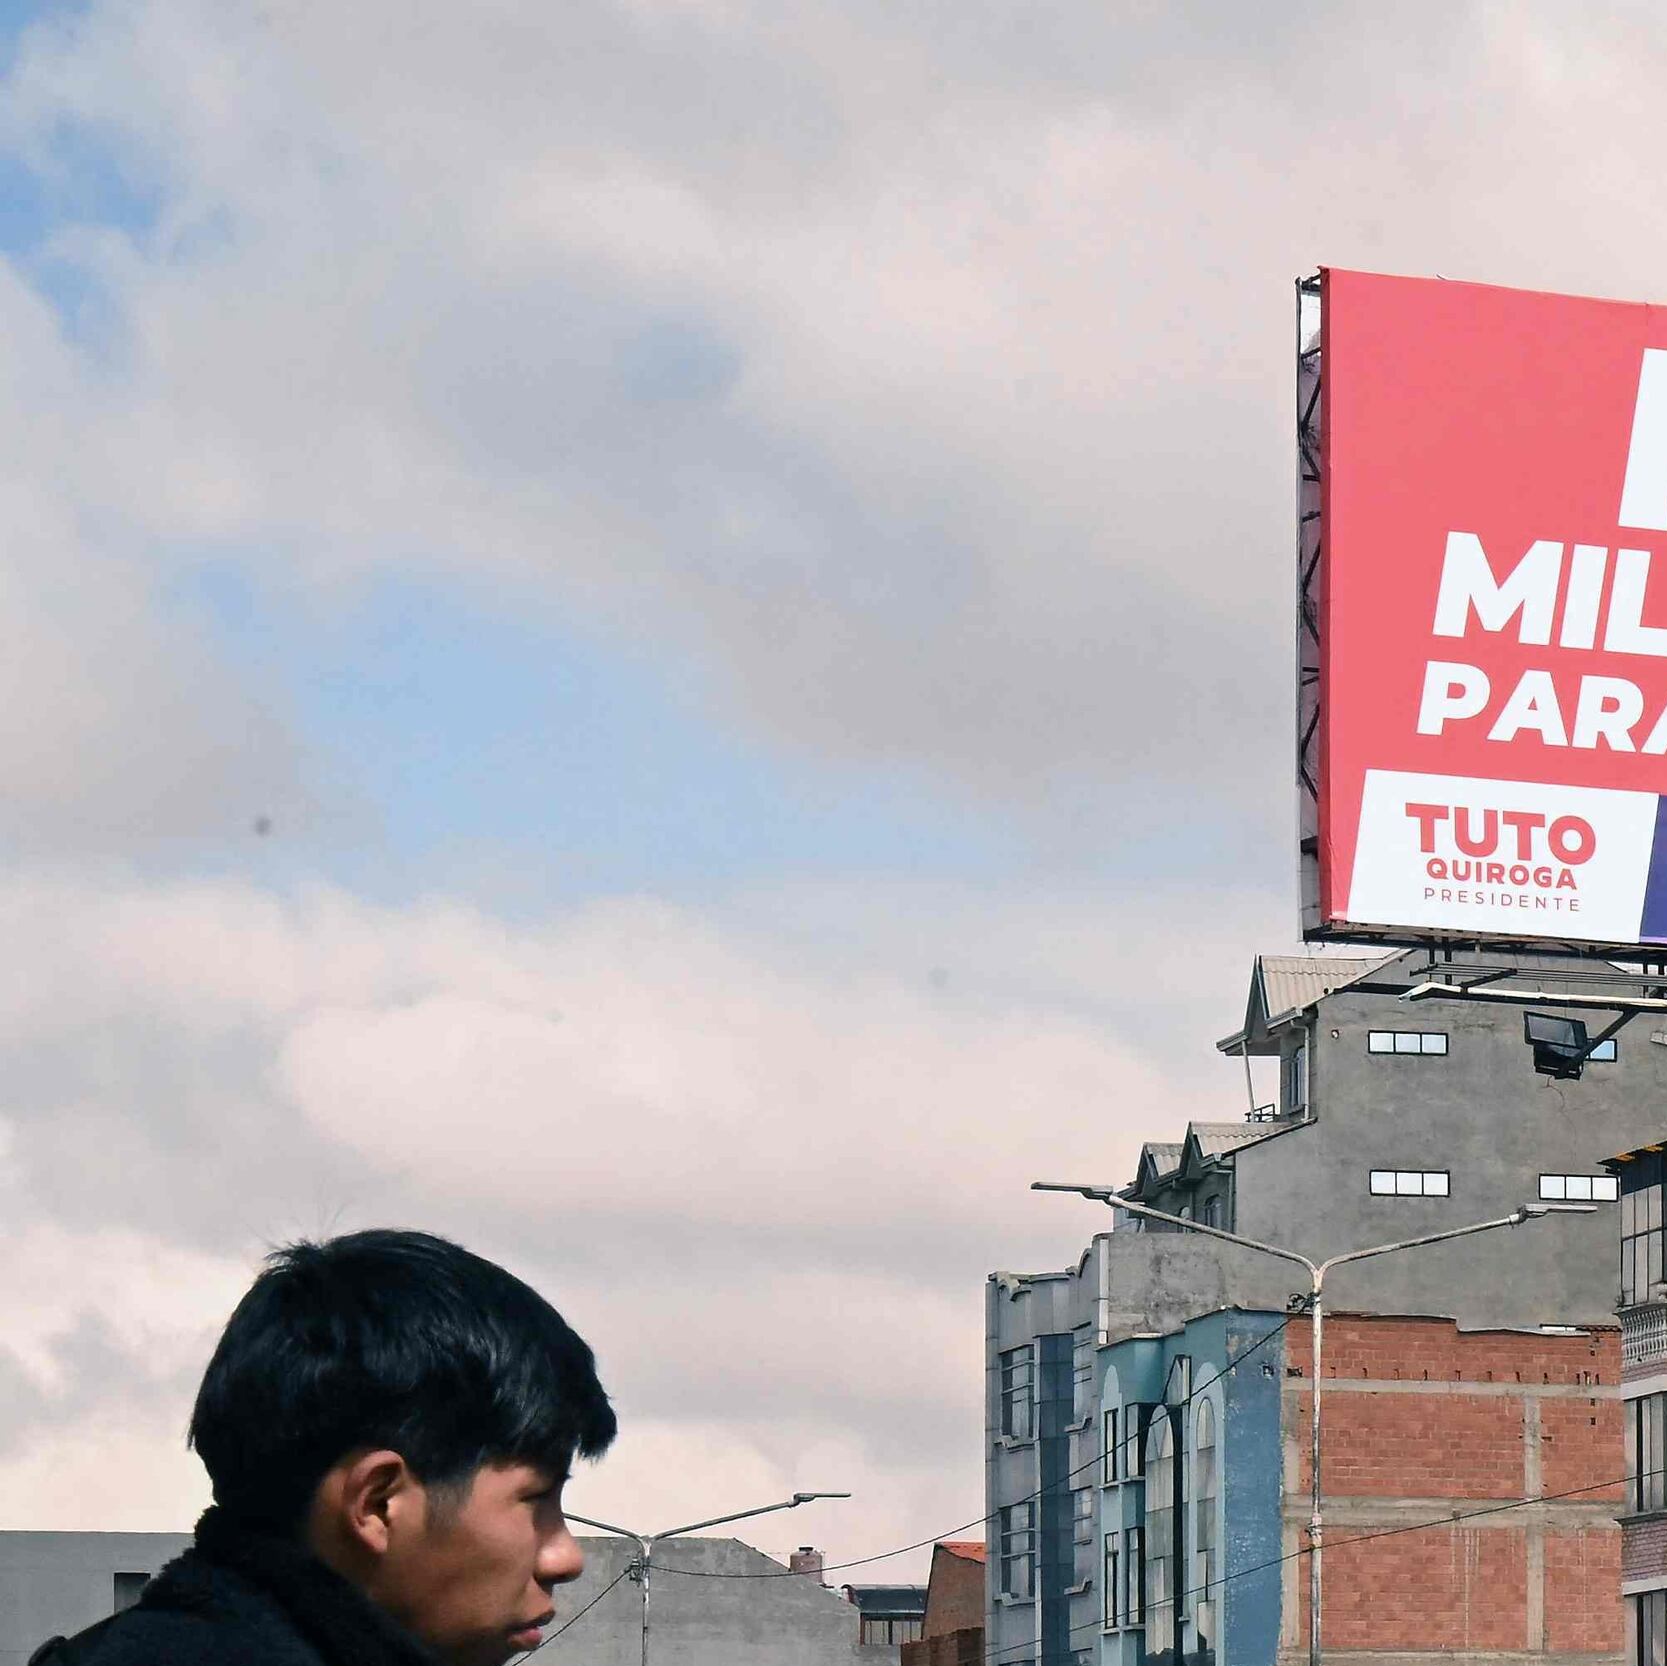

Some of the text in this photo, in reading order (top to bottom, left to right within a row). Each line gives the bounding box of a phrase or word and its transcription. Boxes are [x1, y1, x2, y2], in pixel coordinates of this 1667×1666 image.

[1405, 802, 1596, 866] TUTO
[1426, 858, 1578, 891] QUIROGA
[1424, 887, 1580, 913] PRESIDENTE
